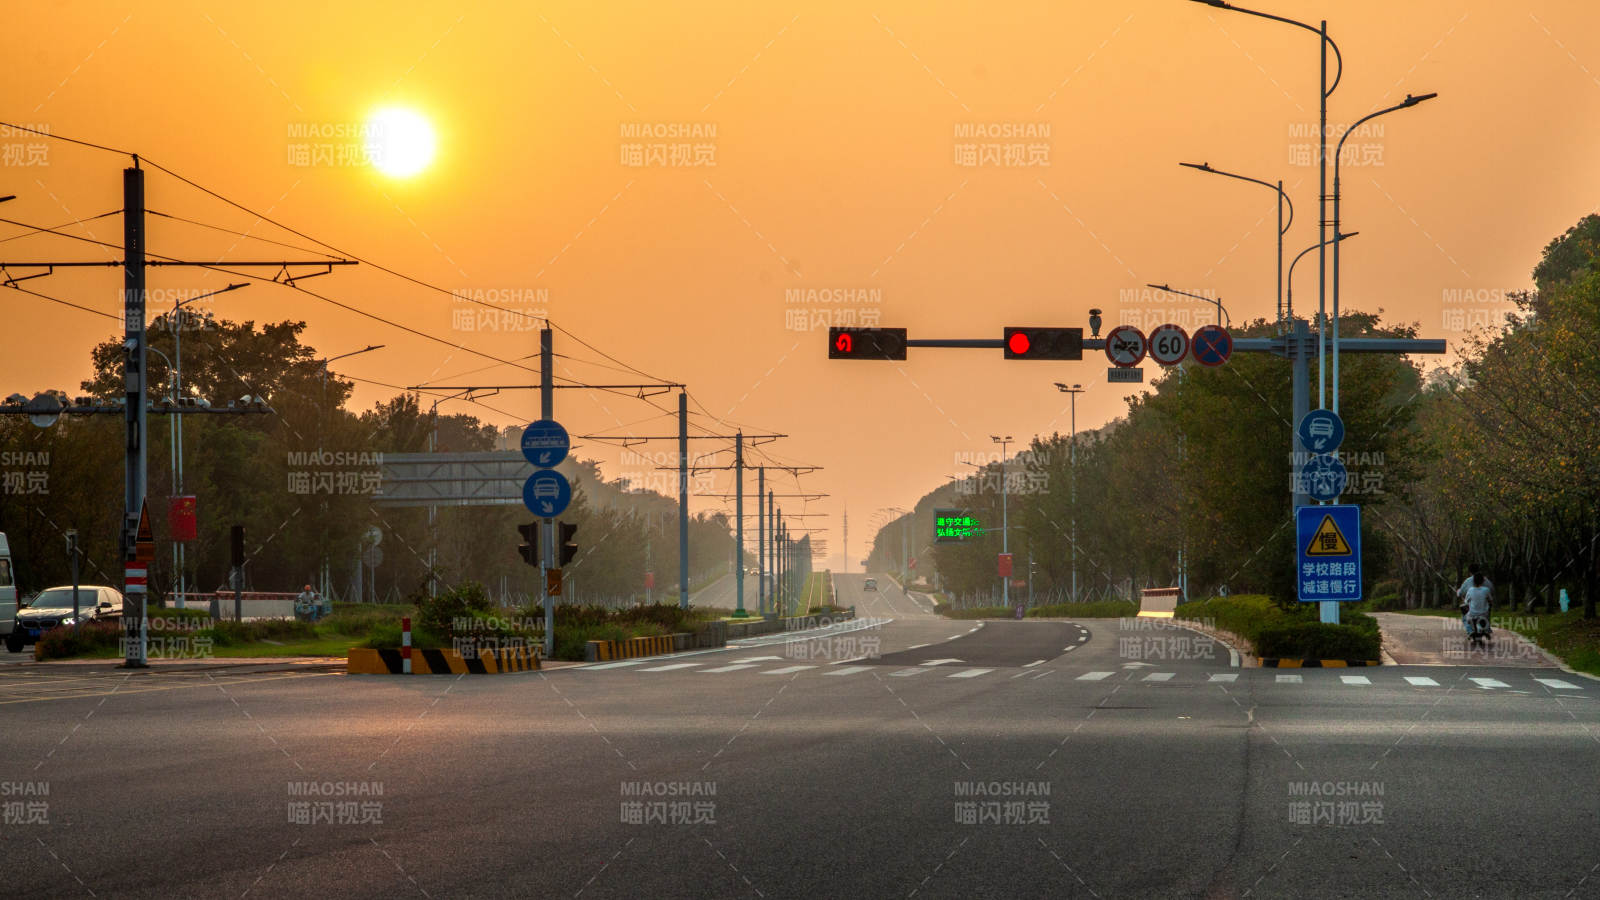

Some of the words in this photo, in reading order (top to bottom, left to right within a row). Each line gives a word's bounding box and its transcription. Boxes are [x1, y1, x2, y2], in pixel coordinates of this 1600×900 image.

[1158, 336, 1181, 355] 60
[1319, 531, 1338, 550] 慢
[1303, 562, 1356, 576] 学校路段
[1303, 580, 1356, 594] 减速慢行
